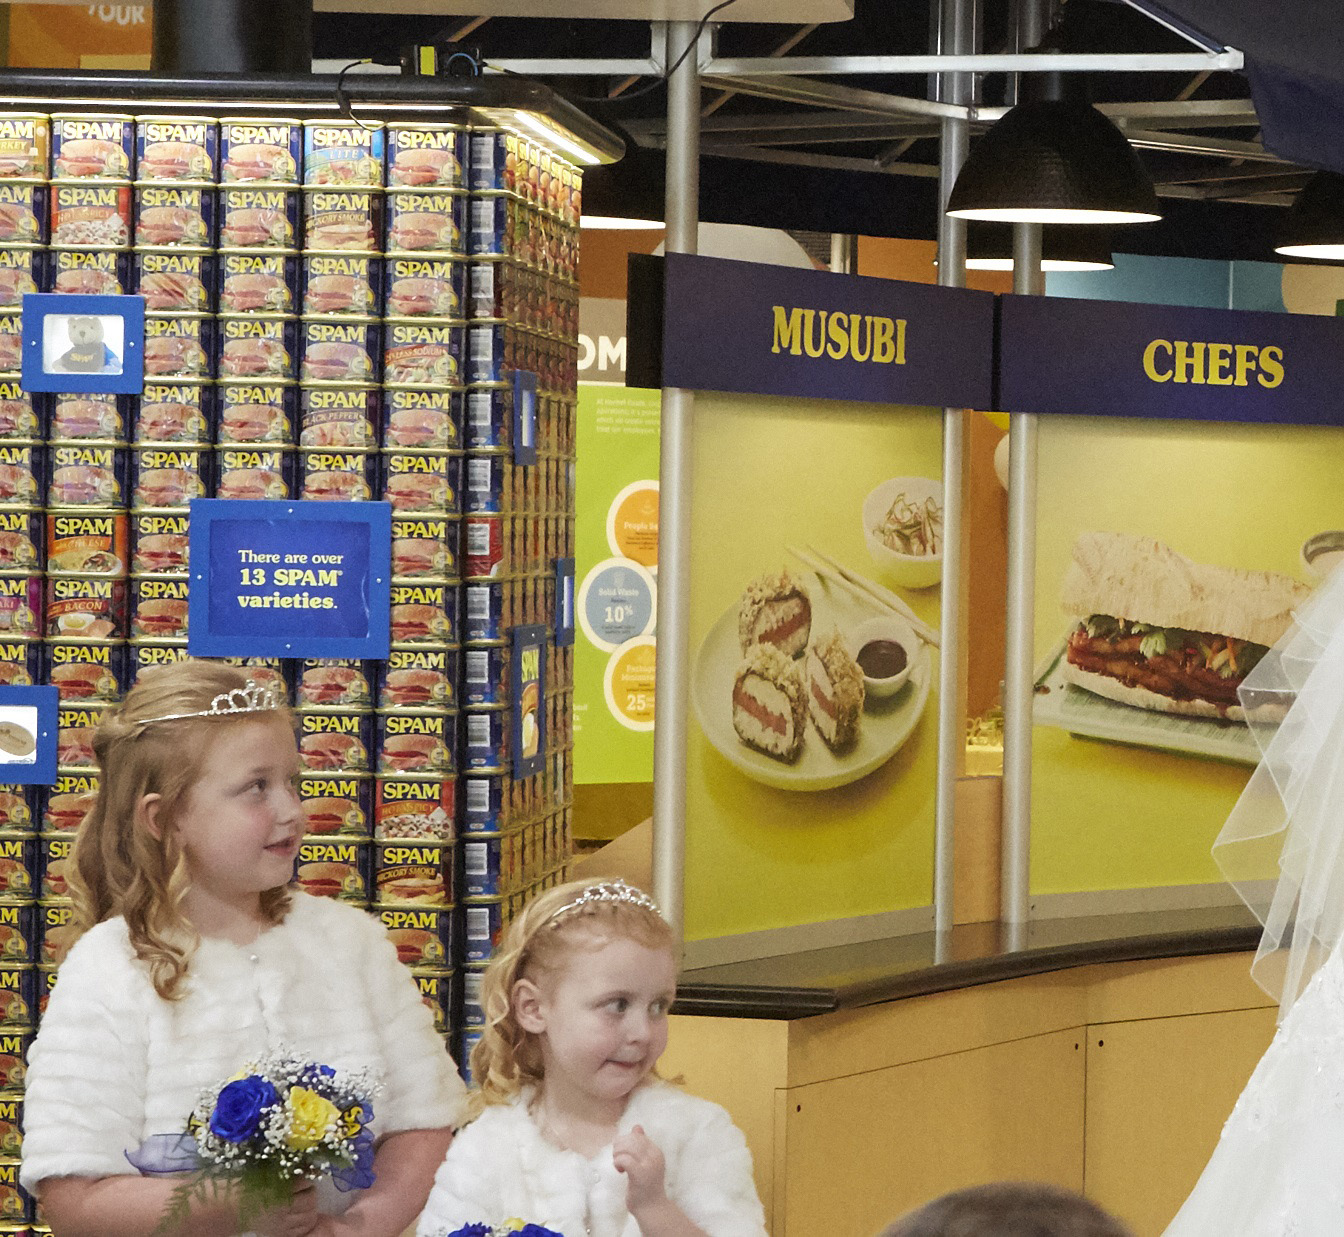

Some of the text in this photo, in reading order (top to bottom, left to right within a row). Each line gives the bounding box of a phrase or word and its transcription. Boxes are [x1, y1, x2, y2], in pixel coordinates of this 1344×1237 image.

[63, 122, 121, 140] SPAM
[147, 125, 206, 143] SPAM
[231, 127, 288, 144] SPAM
[314, 130, 370, 147] SPAM
[398, 132, 455, 148] SPAM
[328, 149, 360, 160] LITE
[59, 188, 116, 205] SPAM
[140, 189, 199, 207] SPAM
[228, 191, 284, 208] SPAM
[312, 193, 369, 211] SPAM
[396, 195, 452, 212] SPAM
[339, 212, 365, 223] SMOKE
[59, 253, 116, 270] SPAM
[143, 254, 199, 273] SPAM
[226, 256, 284, 274] SPAM
[310, 259, 367, 275] SPAM
[396, 261, 451, 278] SPAM
[146, 321, 199, 337] SPAM
[226, 322, 283, 338] SPAM
[309, 325, 365, 343] SPAM
[394, 327, 450, 344] SPAM
[771, 306, 908, 366] MUSUBI
[1142, 337, 1285, 389] CHEFS
[143, 386, 200, 403] SPAM
[226, 387, 283, 404] SPAM
[310, 392, 366, 408] SPAM
[392, 392, 449, 409] SPAM
[55, 449, 112, 466] SPAM
[141, 451, 198, 468] SPAM
[224, 452, 280, 468] SPAM
[307, 454, 364, 471] SPAM
[390, 456, 446, 473] SPAM
[56, 518, 113, 535] SPAM
[238, 549, 344, 565] There are over
[240, 568, 266, 586] 13
[55, 581, 112, 598] SPAM
[65, 600, 103, 612] BACON
[237, 592, 338, 609] varieties.
[53, 646, 110, 663] SPAM
[389, 652, 445, 669] SPAM
[302, 716, 360, 733] SPAM
[386, 717, 443, 734] SPAM
[301, 780, 357, 797] SPAM
[384, 783, 440, 799] SPAM
[299, 846, 356, 862] SPAM
[384, 848, 440, 865] SPAM
[408, 866, 436, 877] SMOKE
[381, 912, 437, 929] SPAM
